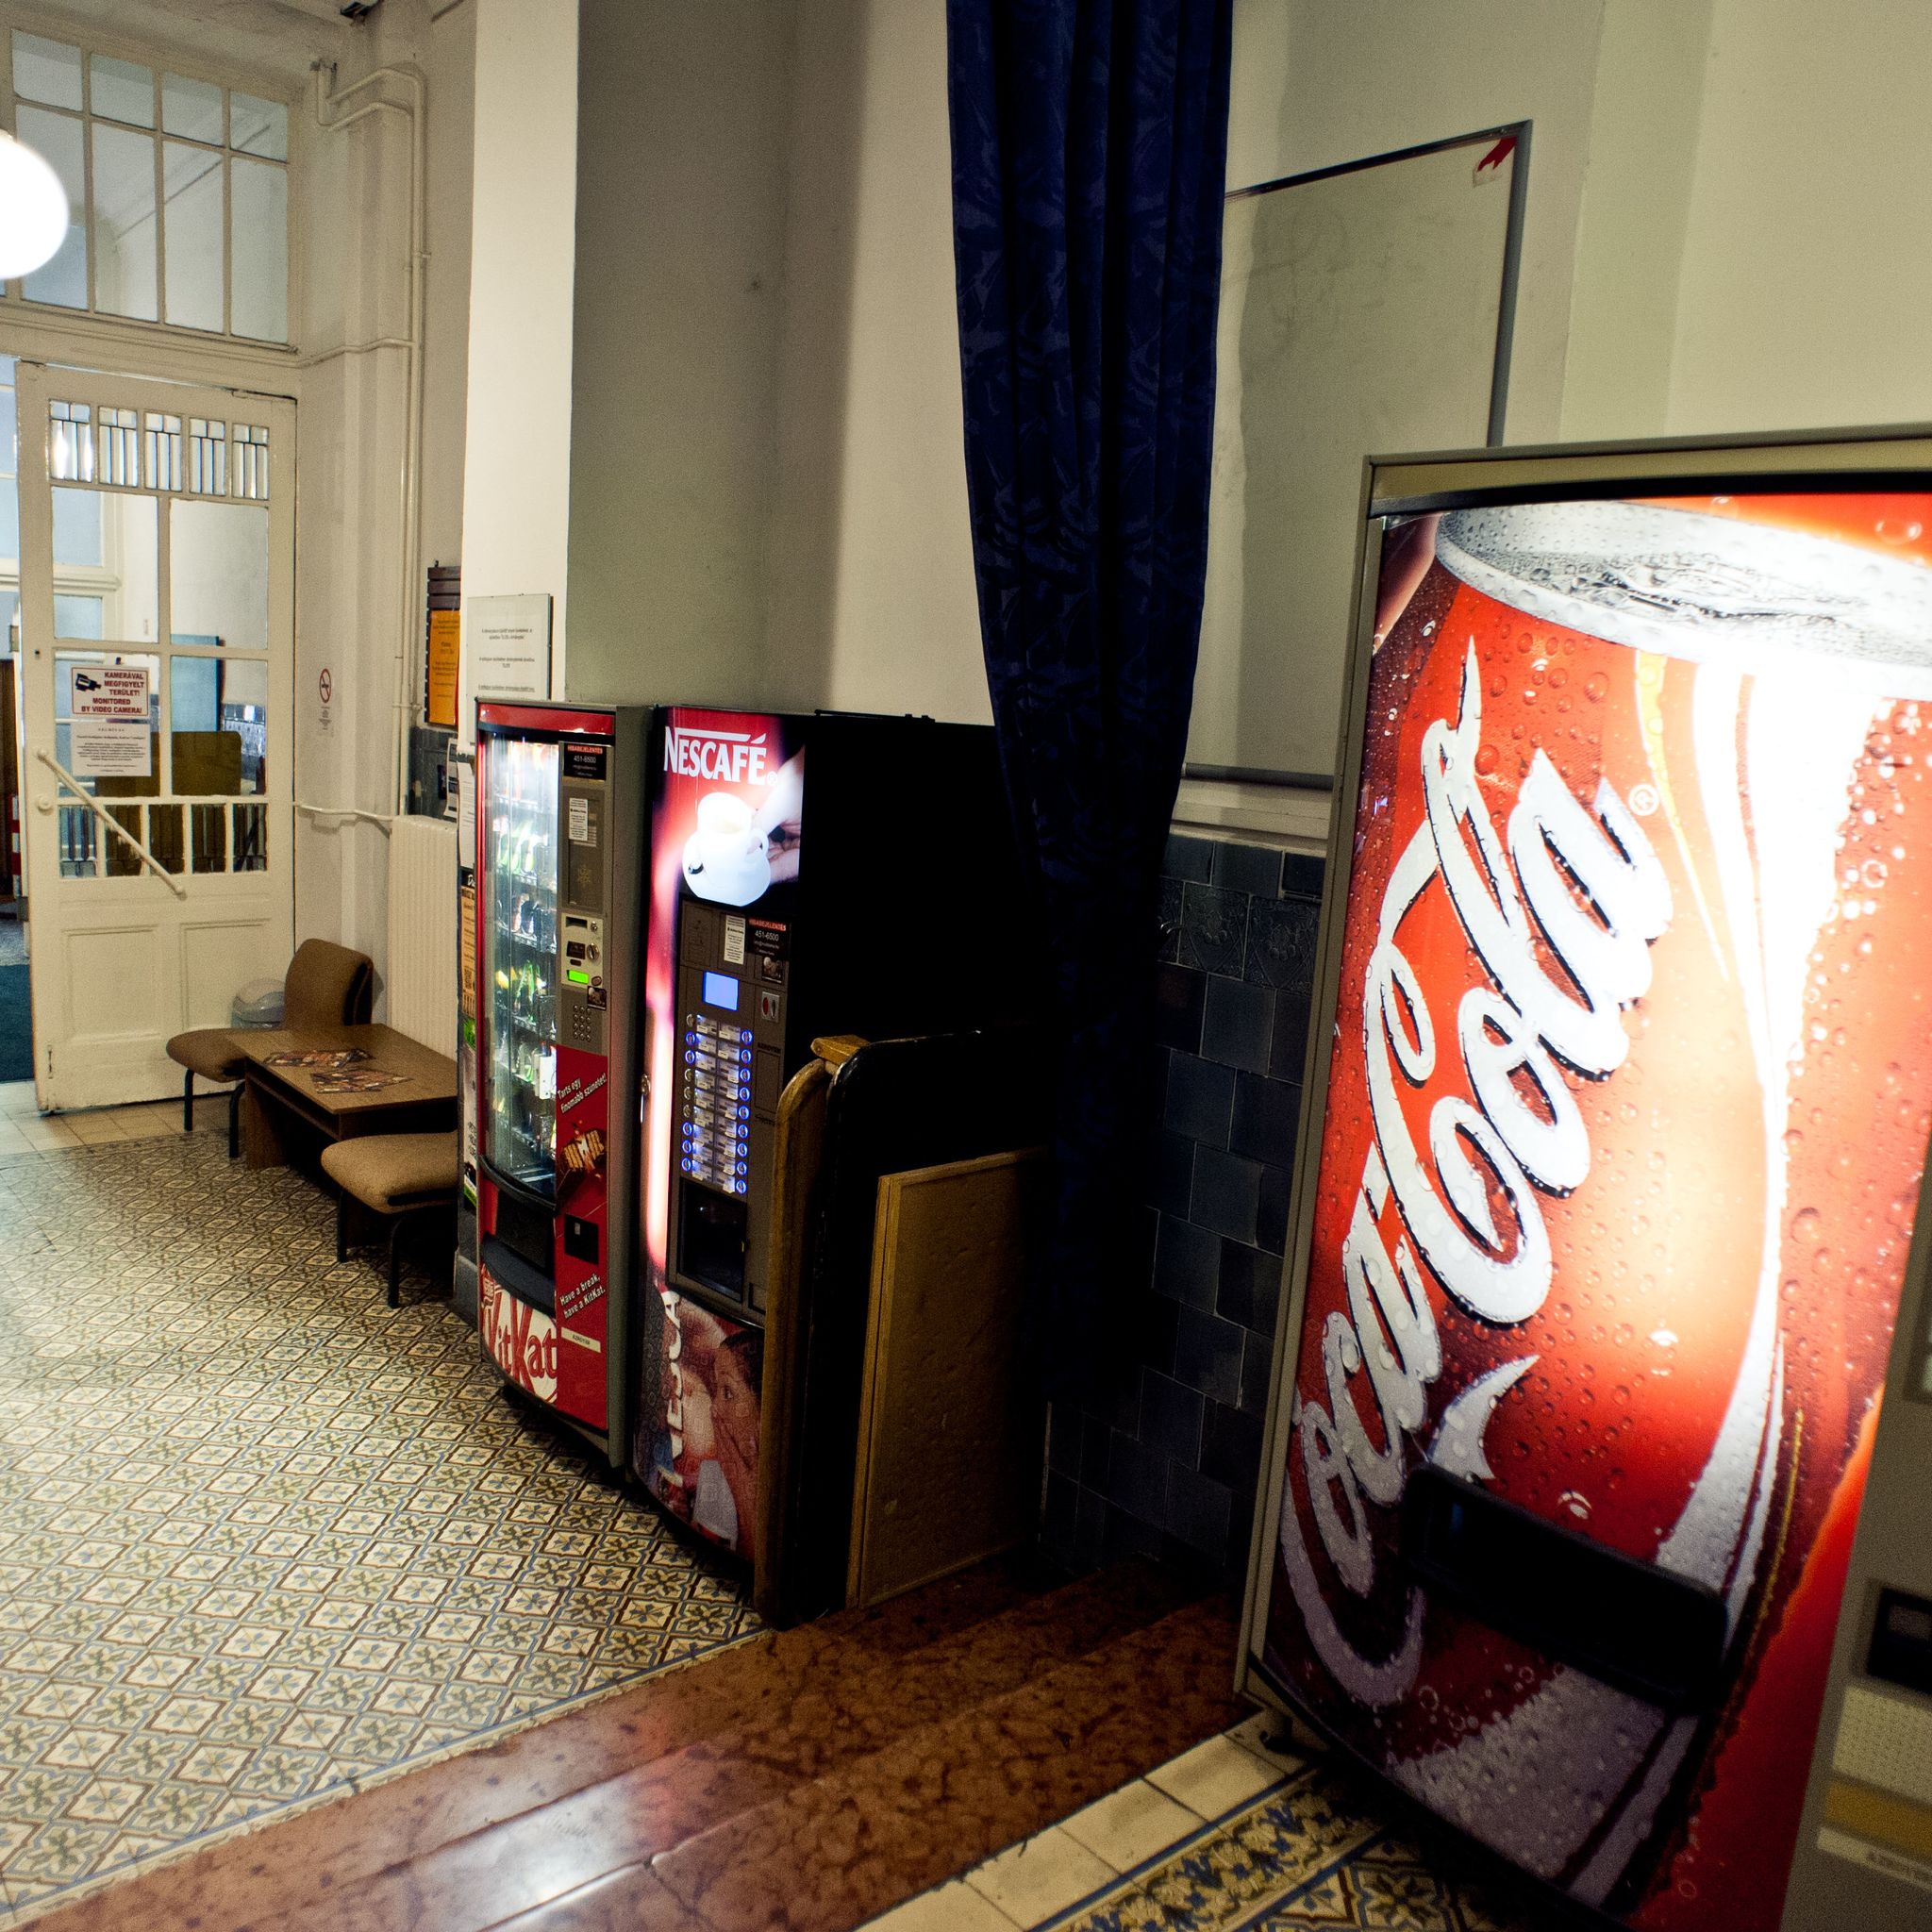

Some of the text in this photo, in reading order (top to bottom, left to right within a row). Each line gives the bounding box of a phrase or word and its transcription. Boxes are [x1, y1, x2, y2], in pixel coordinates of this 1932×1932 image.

[104, 672, 144, 680] KAMERÁVAL
[104, 680, 145, 689] MEGFIGYELT
[92, 697, 131, 706] MONITORED
[663, 725, 767, 786] NESCAFÉ
[571, 1077, 581, 1091] egy
[1280, 635, 1673, 1707] Coca-Cola
[559, 1291, 575, 1307] Have
[575, 1287, 581, 1296] a
[563, 1304, 578, 1319] have
[578, 1300, 584, 1309] a
